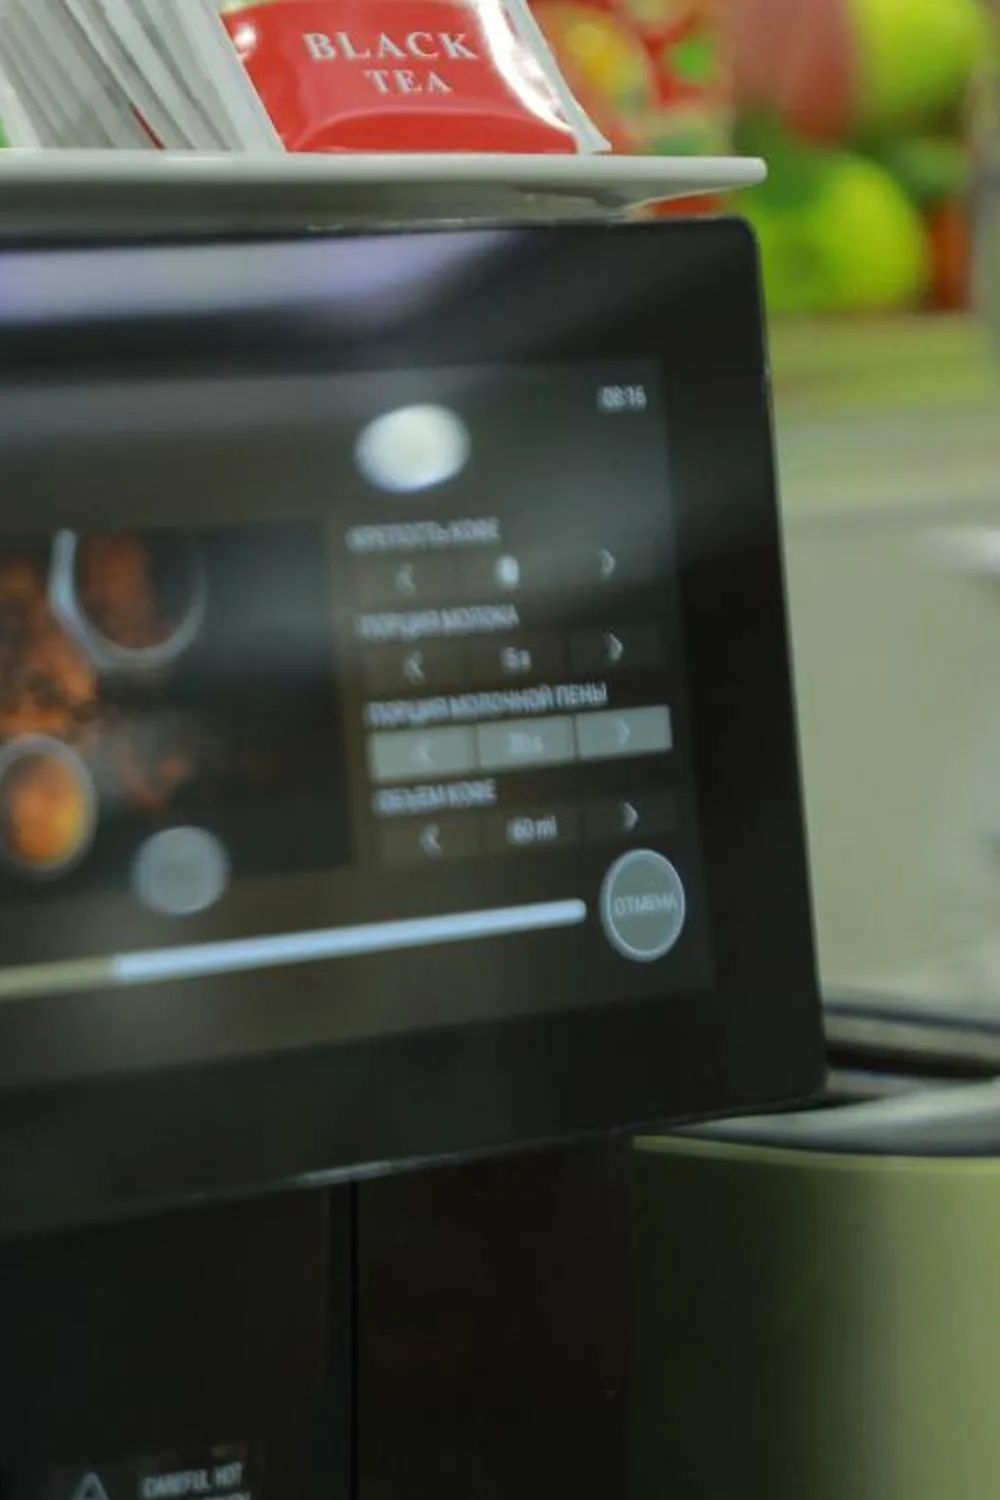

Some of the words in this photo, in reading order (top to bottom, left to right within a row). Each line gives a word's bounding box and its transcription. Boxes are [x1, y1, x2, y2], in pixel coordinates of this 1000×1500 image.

[302, 31, 478, 62] BLACK
[363, 69, 452, 94] TEA
[554, 682, 608, 709] ПЕНЫ
[213, 1461, 243, 1488] HOT
